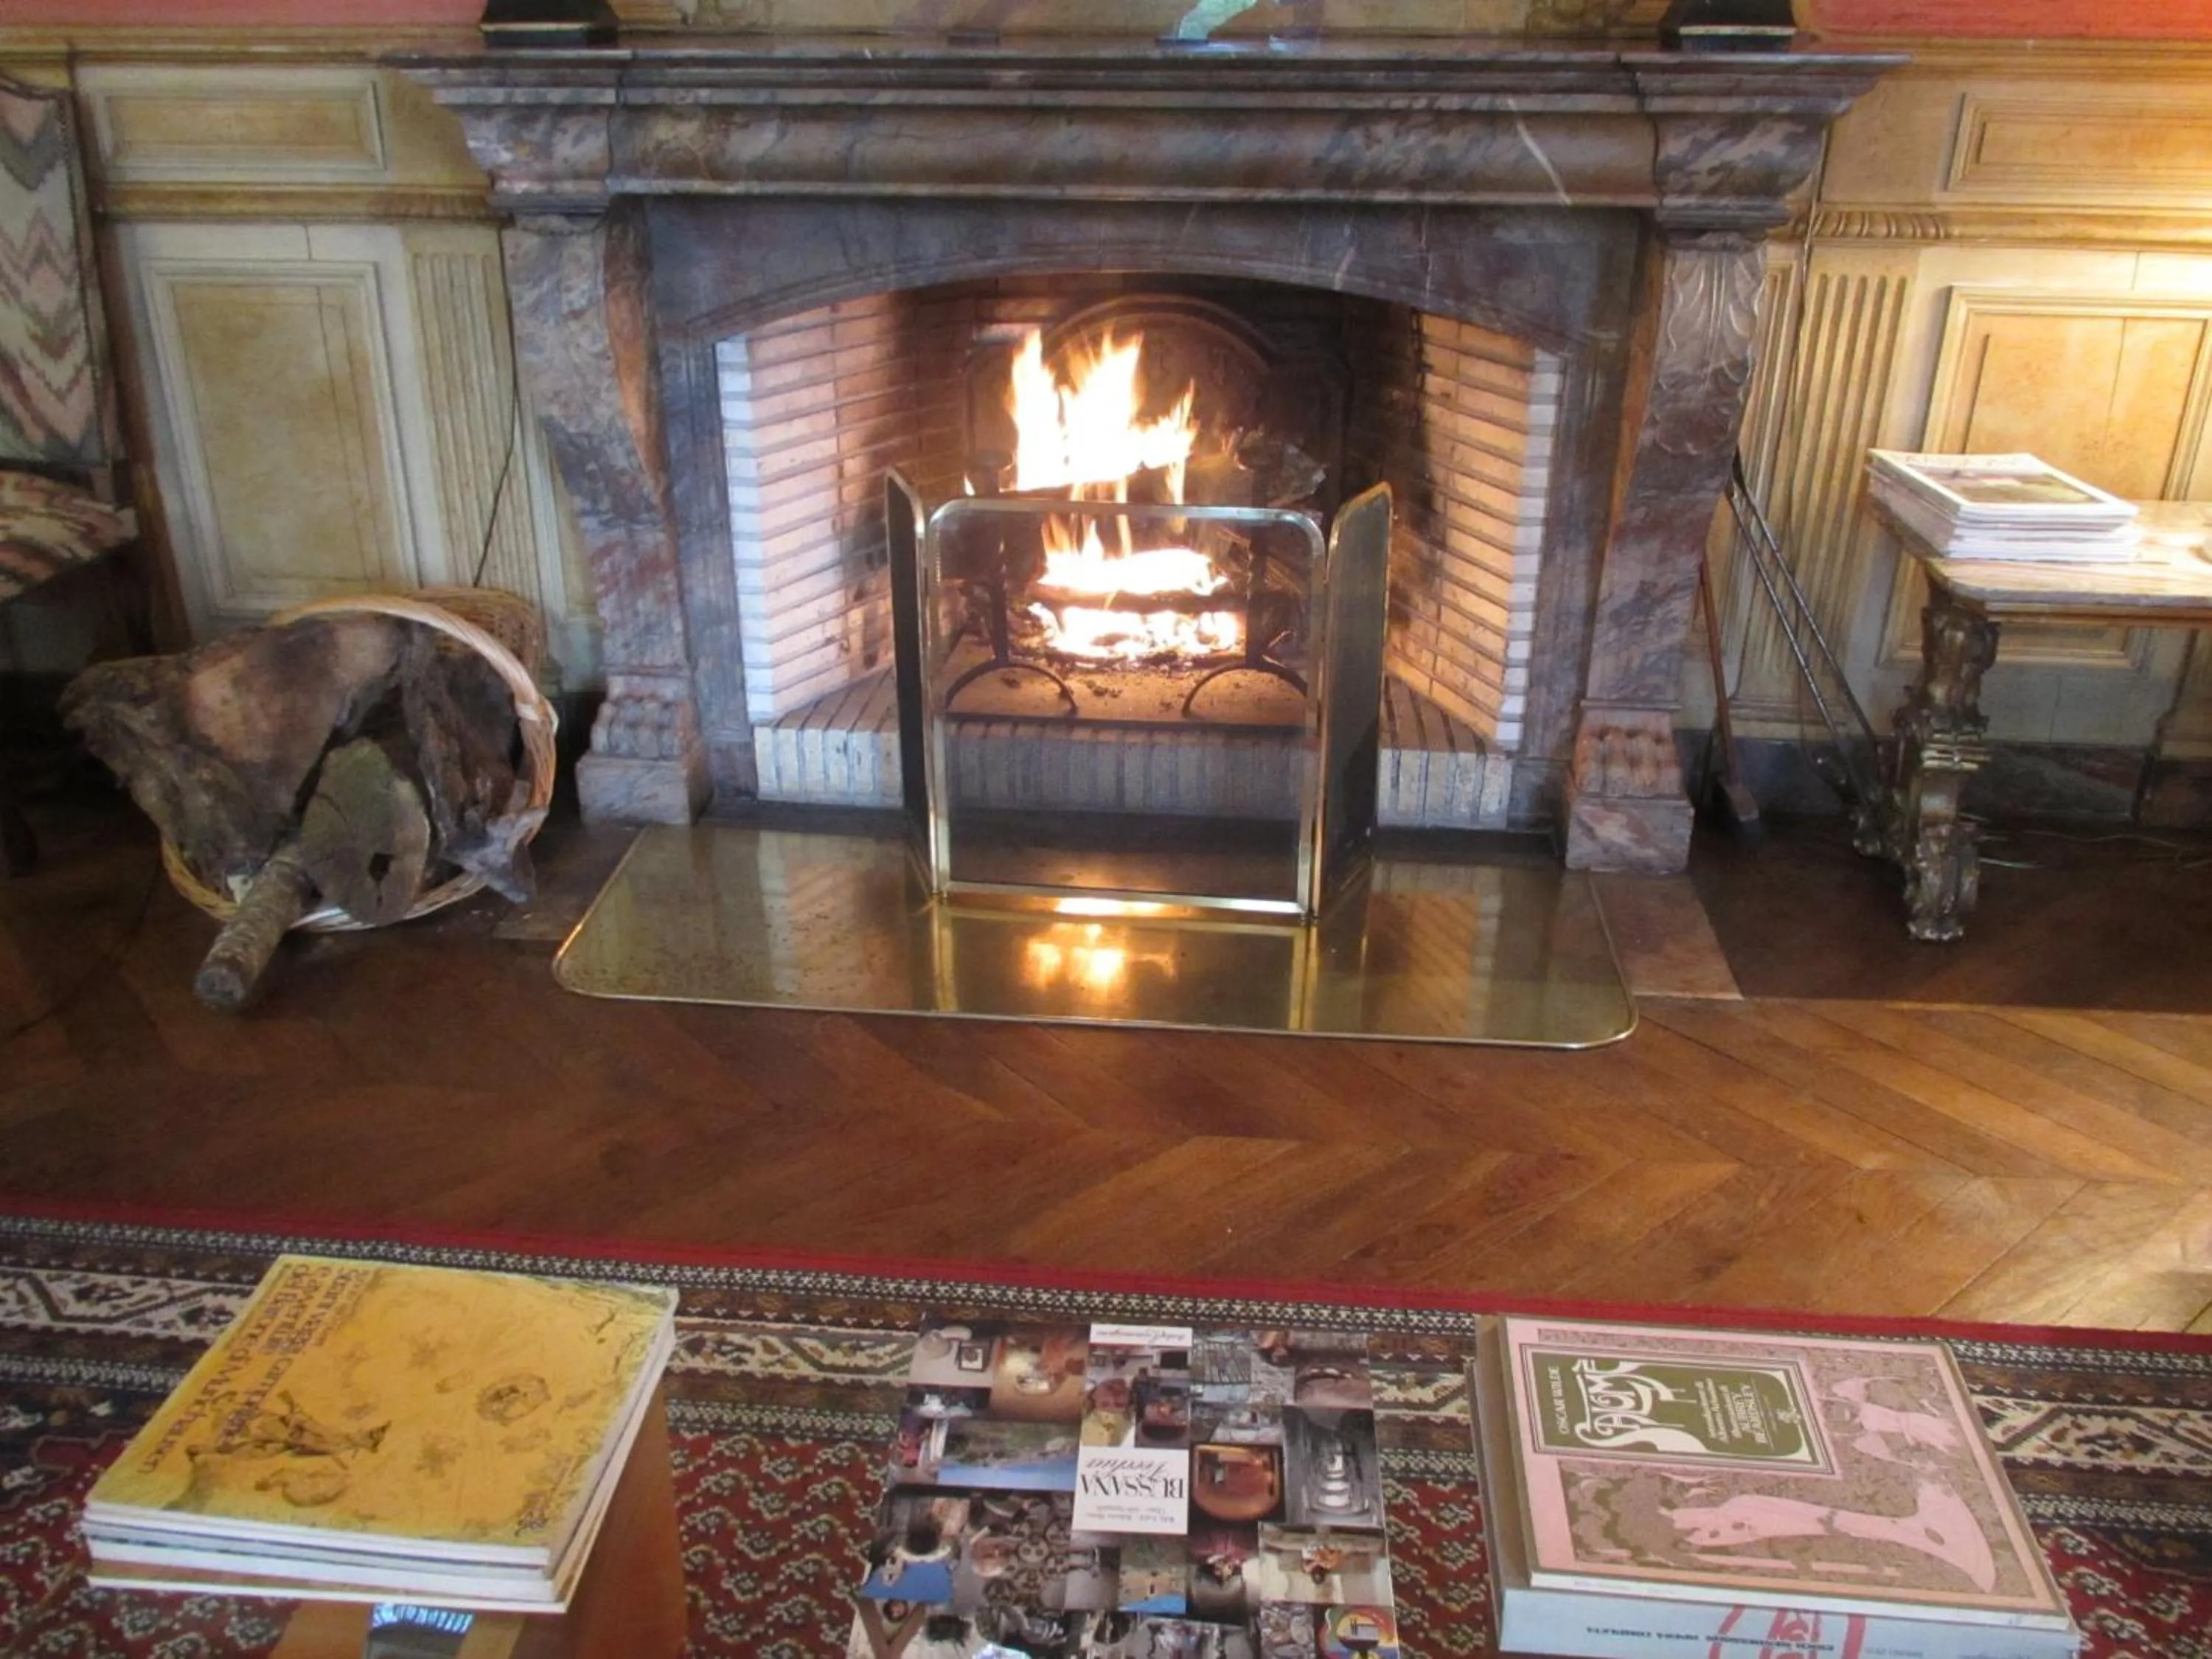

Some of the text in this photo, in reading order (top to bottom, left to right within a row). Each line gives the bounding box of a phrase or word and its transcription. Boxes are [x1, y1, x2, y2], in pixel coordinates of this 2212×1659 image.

[1548, 1366, 1571, 1436] OSCAR WILDE
[1080, 1474, 1184, 1499] BUSSANA
